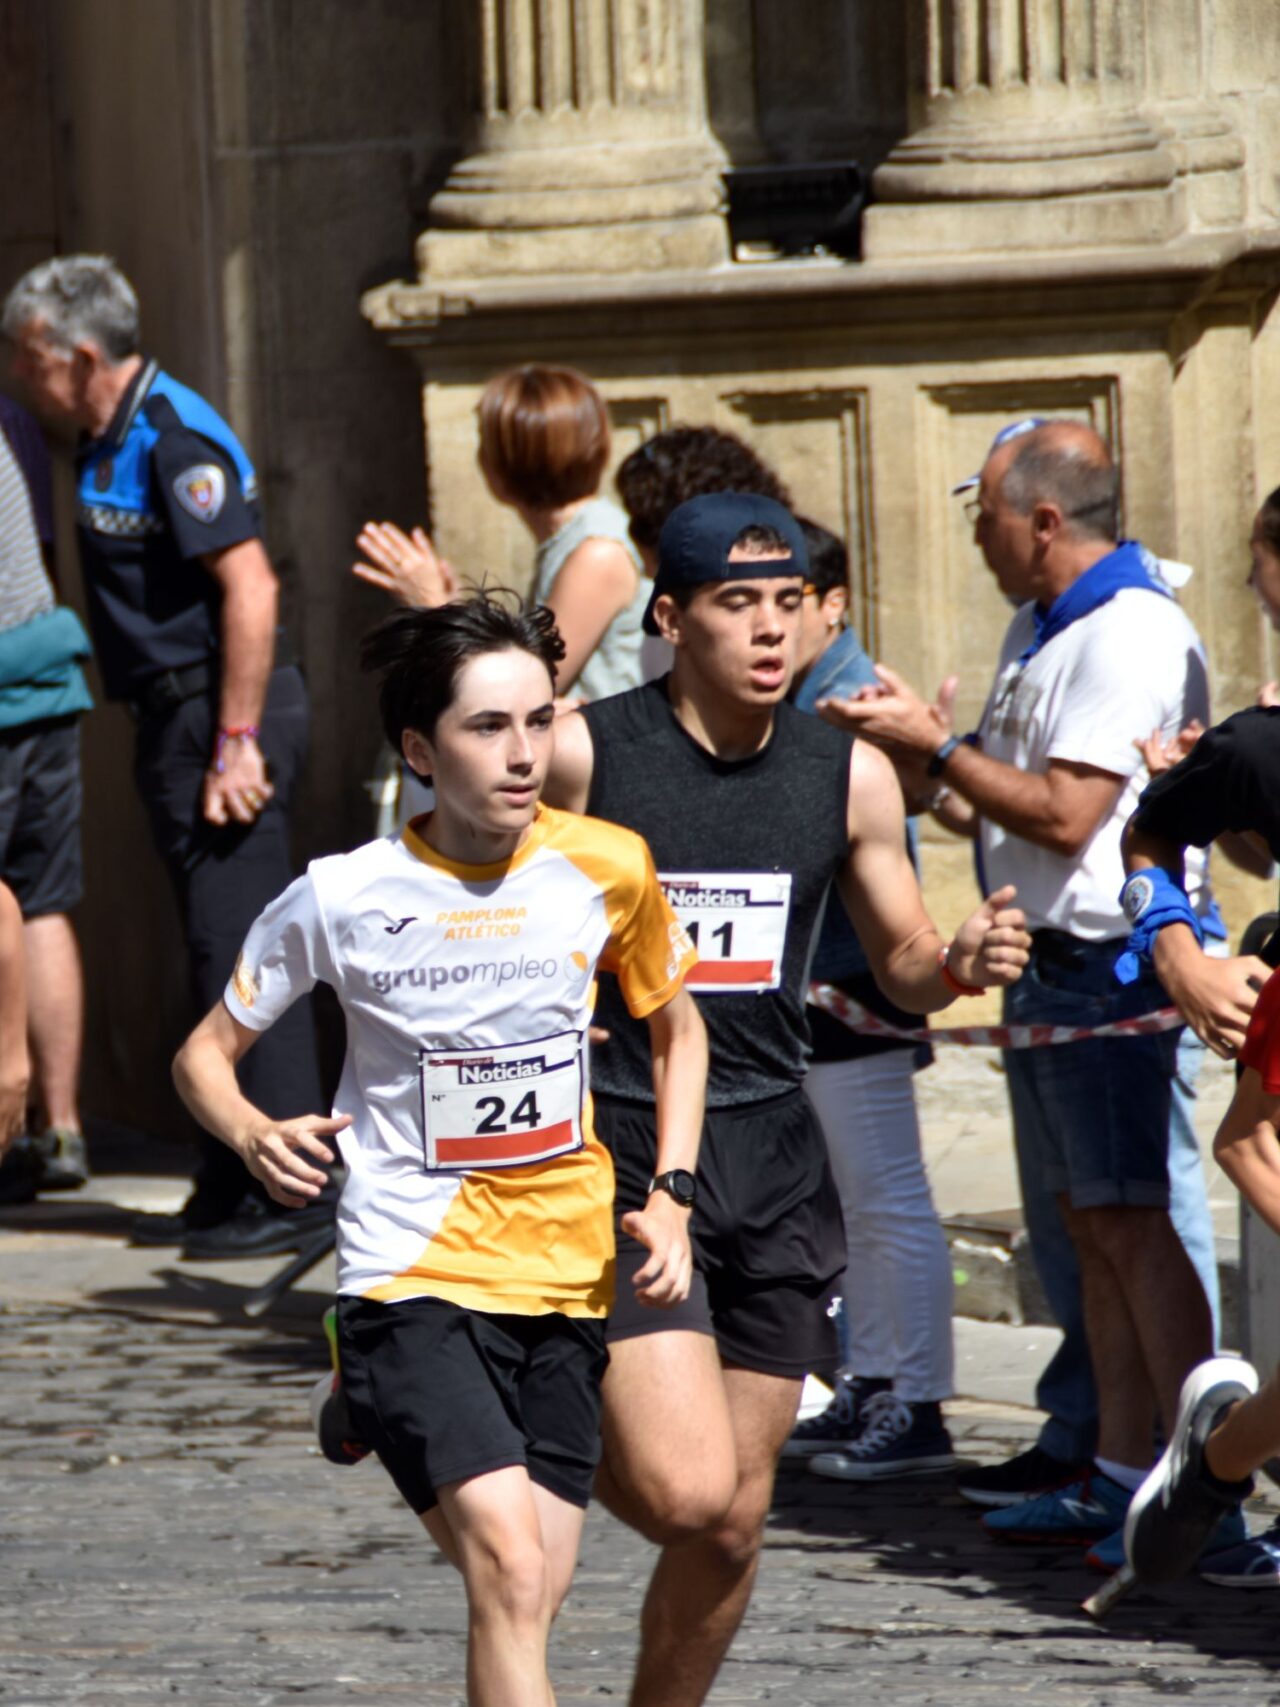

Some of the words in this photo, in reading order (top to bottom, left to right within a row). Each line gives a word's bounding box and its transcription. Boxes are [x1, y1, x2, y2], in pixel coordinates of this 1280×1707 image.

[667, 888, 747, 907] Noticias
[436, 907, 527, 925] PAMPLONA
[443, 923, 521, 941] ATLÉTICO
[371, 954, 558, 995] grupompleo
[461, 1060, 543, 1085] Noticias
[475, 1090, 542, 1135] 24
